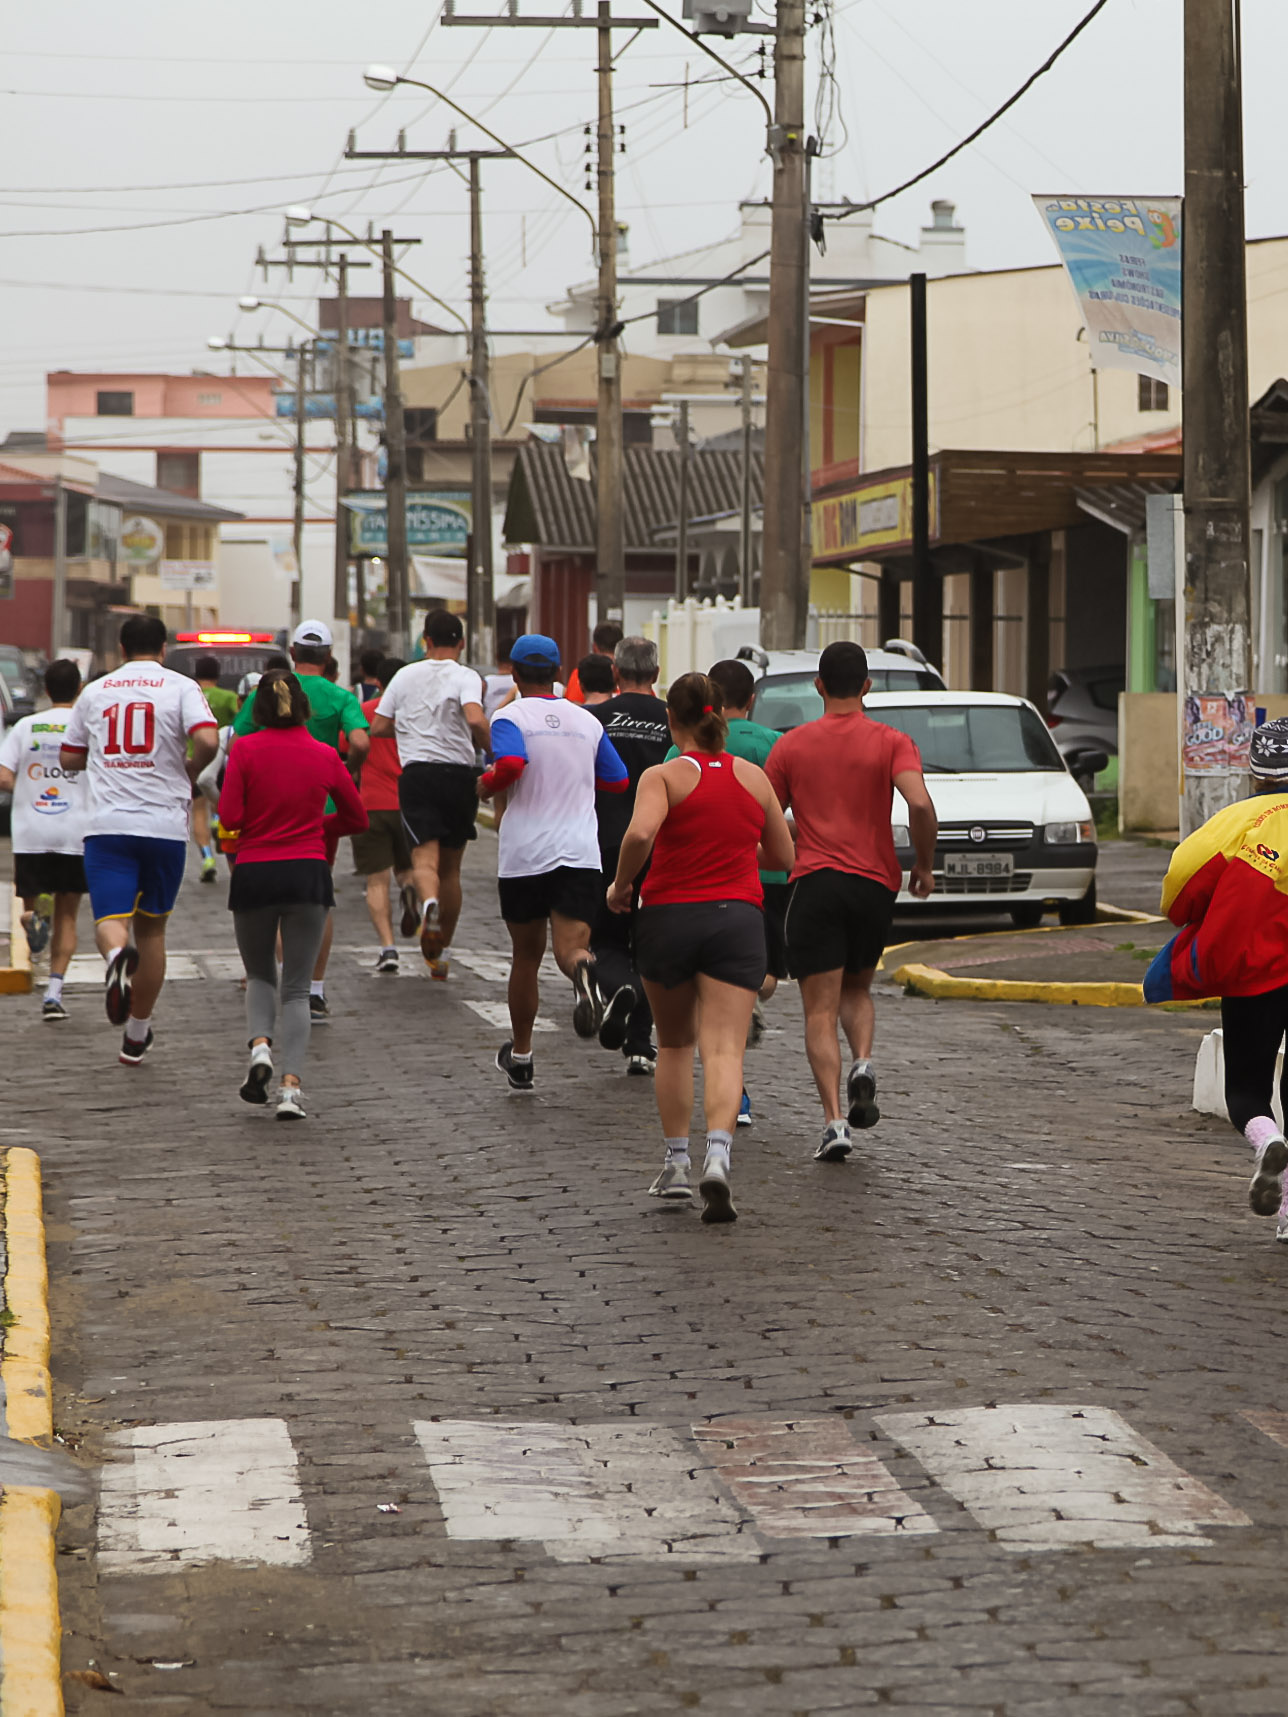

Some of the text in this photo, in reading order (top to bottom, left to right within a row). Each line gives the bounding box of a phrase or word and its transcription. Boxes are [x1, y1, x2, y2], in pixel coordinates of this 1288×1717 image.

[103, 676, 165, 689] Banrisul
[102, 701, 155, 754] 10
[607, 712, 667, 732] Zircon
[1186, 727, 1224, 746] GOOD
